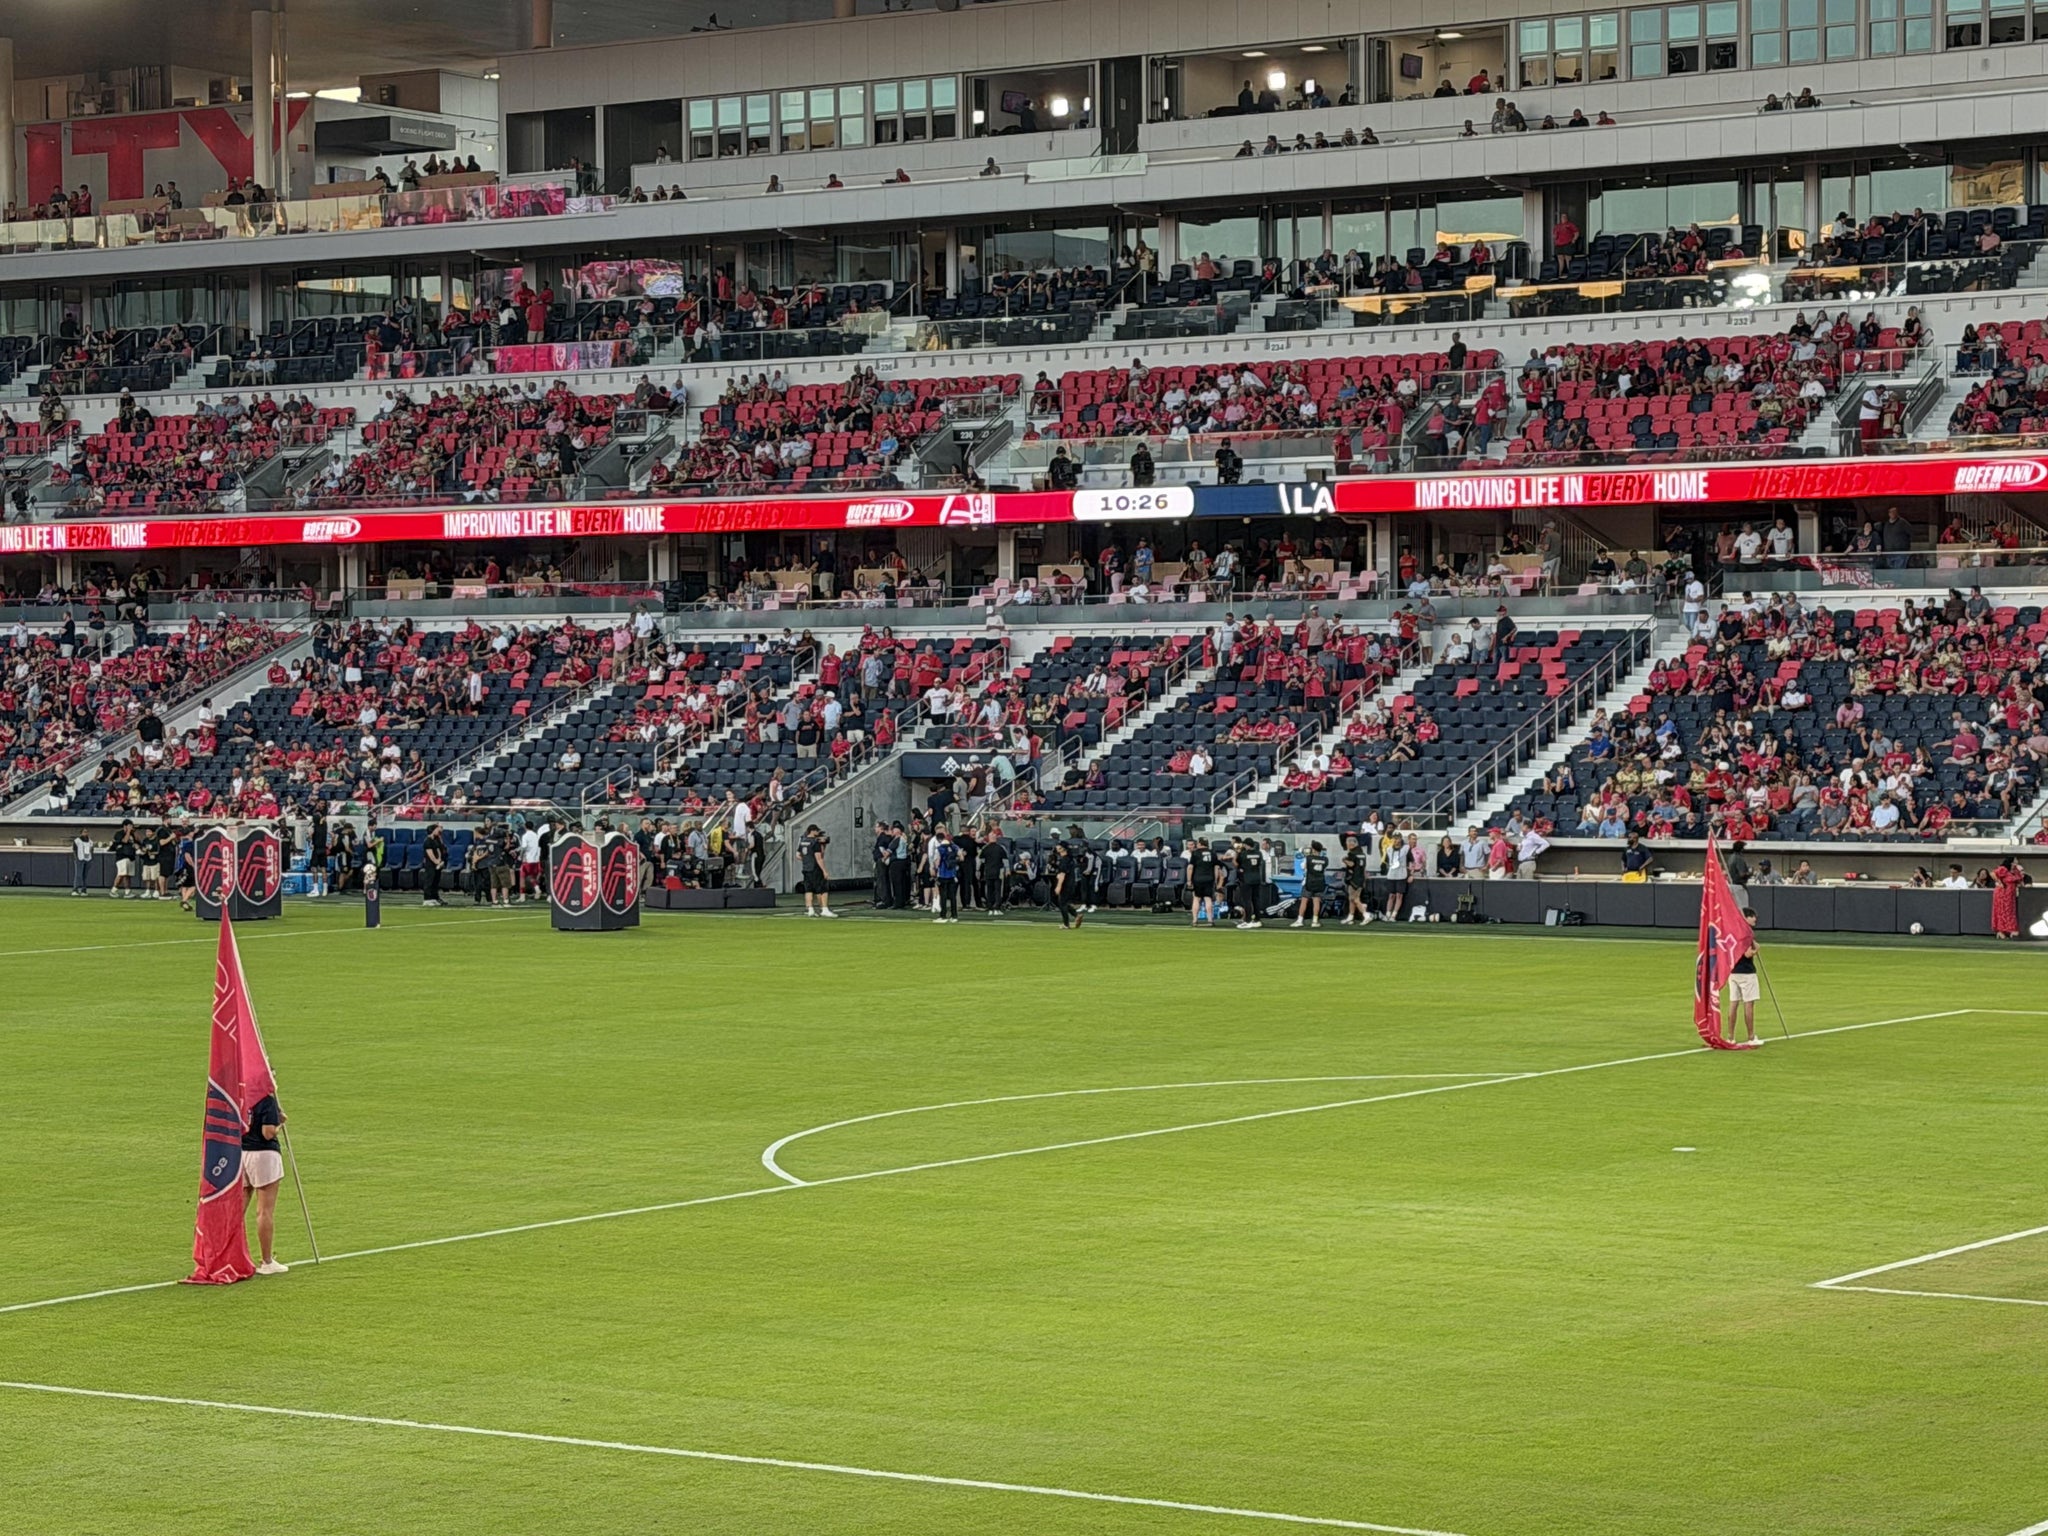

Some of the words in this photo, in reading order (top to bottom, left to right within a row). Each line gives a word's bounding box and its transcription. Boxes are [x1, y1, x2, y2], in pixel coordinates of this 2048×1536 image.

[1415, 478, 1516, 508] IMPROVING
[1520, 476, 1557, 505] LIFE
[1564, 475, 1583, 504] IN
[1587, 473, 1651, 502] EVERY
[1653, 471, 1709, 500] HOME
[1955, 464, 2035, 484] HOFFMANN
[1100, 493, 1168, 512] 10:26
[0, 527, 22, 551] ING
[25, 526, 52, 550] LIFE
[54, 525, 66, 549] IN
[68, 526, 109, 547] EVERY
[111, 522, 147, 547] HOME
[444, 511, 521, 539] IMPROVING
[523, 510, 553, 535] LIFE
[556, 509, 571, 533] IN
[573, 508, 621, 532] EVERY
[623, 506, 665, 531] HOME
[222, 846, 230, 888] CITY
[266, 845, 274, 885] CITY
[583, 852, 592, 896] CITY
[625, 850, 634, 895] CITY
